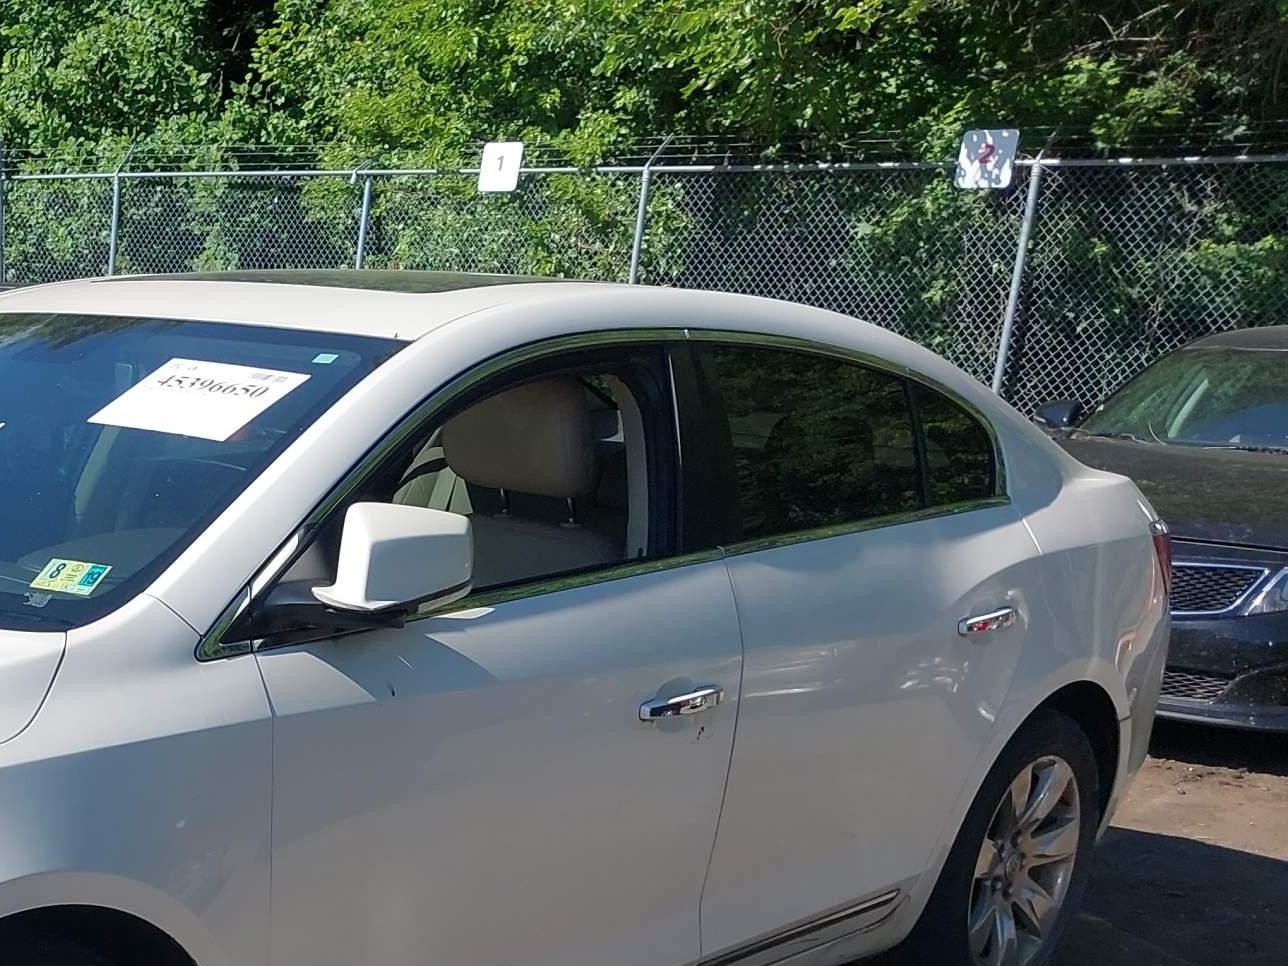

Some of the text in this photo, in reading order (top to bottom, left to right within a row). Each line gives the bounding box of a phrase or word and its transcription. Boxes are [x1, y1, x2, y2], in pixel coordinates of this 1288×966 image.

[496, 155, 504, 171] 1
[978, 144, 996, 164] 2
[157, 375, 269, 398] 45396650
